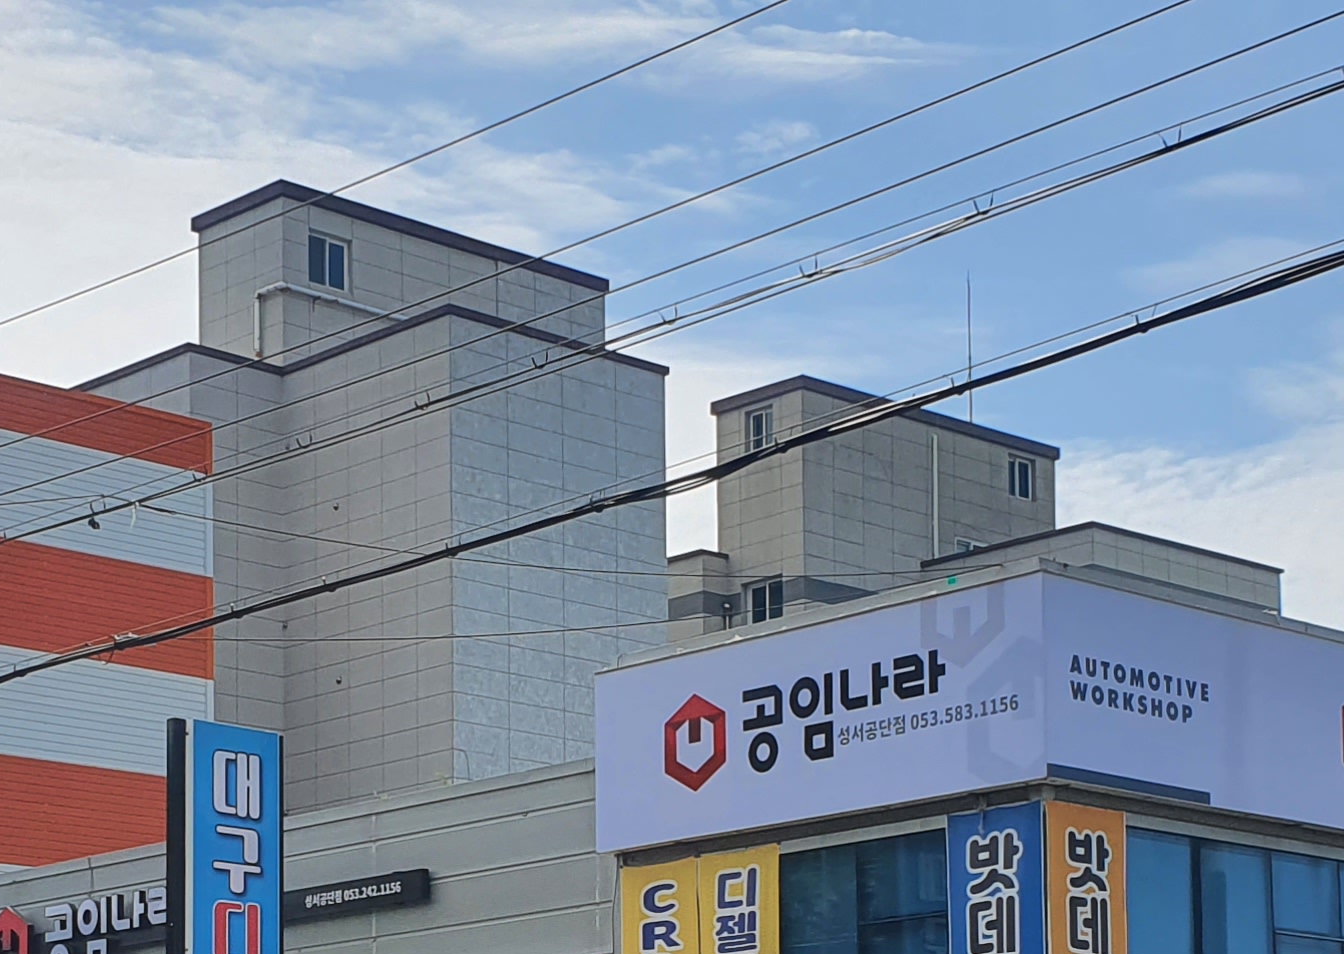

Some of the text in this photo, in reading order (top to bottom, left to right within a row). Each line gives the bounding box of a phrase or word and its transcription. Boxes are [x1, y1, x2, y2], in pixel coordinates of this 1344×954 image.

[1069, 654, 1209, 702] AUTOMOTIVE
[1069, 680, 1193, 723] WORKSHOP
[742, 649, 946, 773] 공임나라
[837, 694, 1020, 746] 성서공단점 053.583.1156
[343, 881, 402, 902] 053.242.1156
